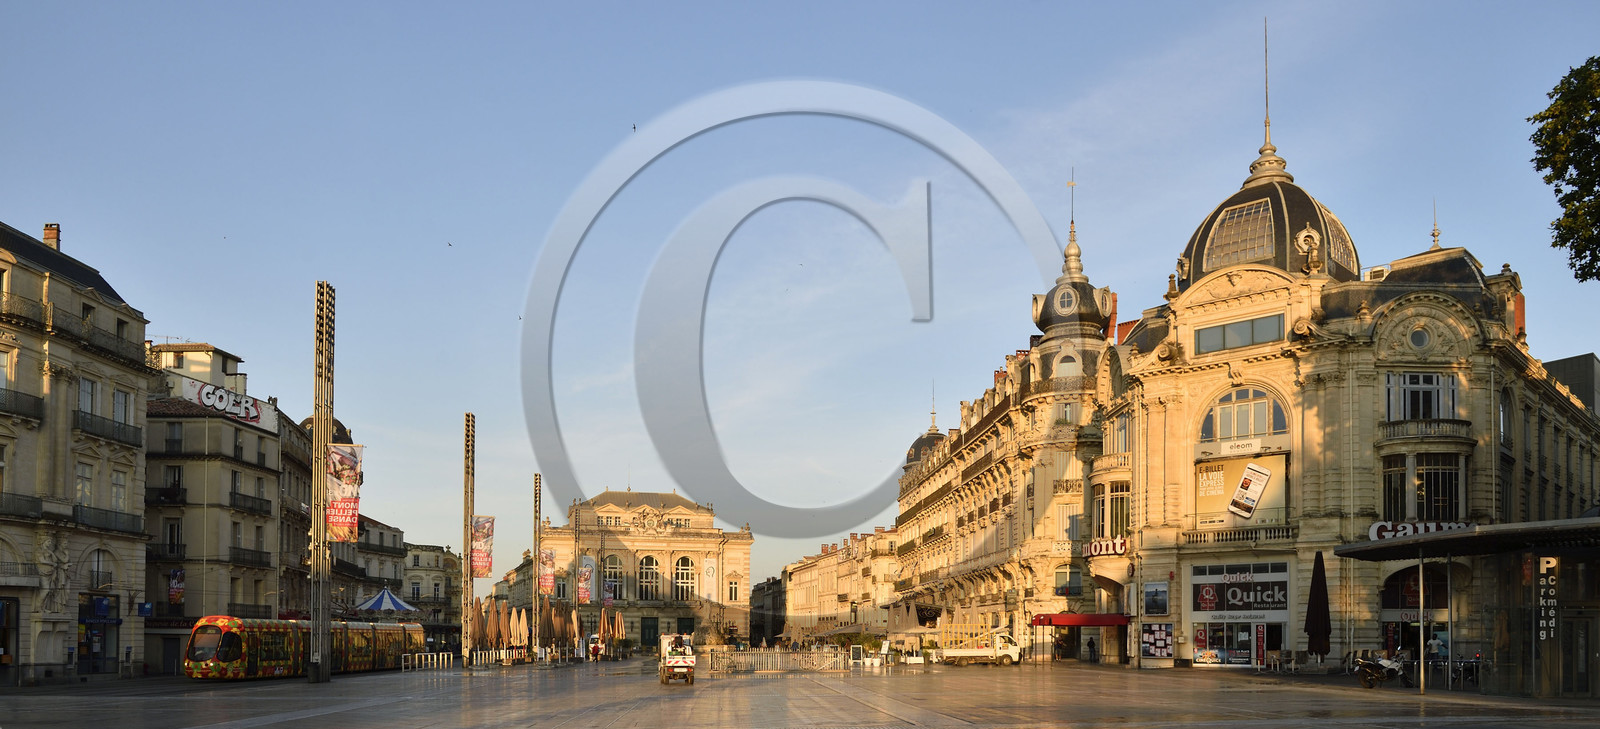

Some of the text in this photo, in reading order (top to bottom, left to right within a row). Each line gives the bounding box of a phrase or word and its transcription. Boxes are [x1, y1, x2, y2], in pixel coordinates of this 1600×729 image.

[201, 384, 259, 419] GOER
[1199, 464, 1224, 473] E-BILLET
[1199, 471, 1224, 481] LA VOIE
[1199, 479, 1225, 488] EXPRESS
[1221, 572, 1254, 584] Quick
[1202, 587, 1214, 599] Q
[1227, 585, 1287, 606] Quick
